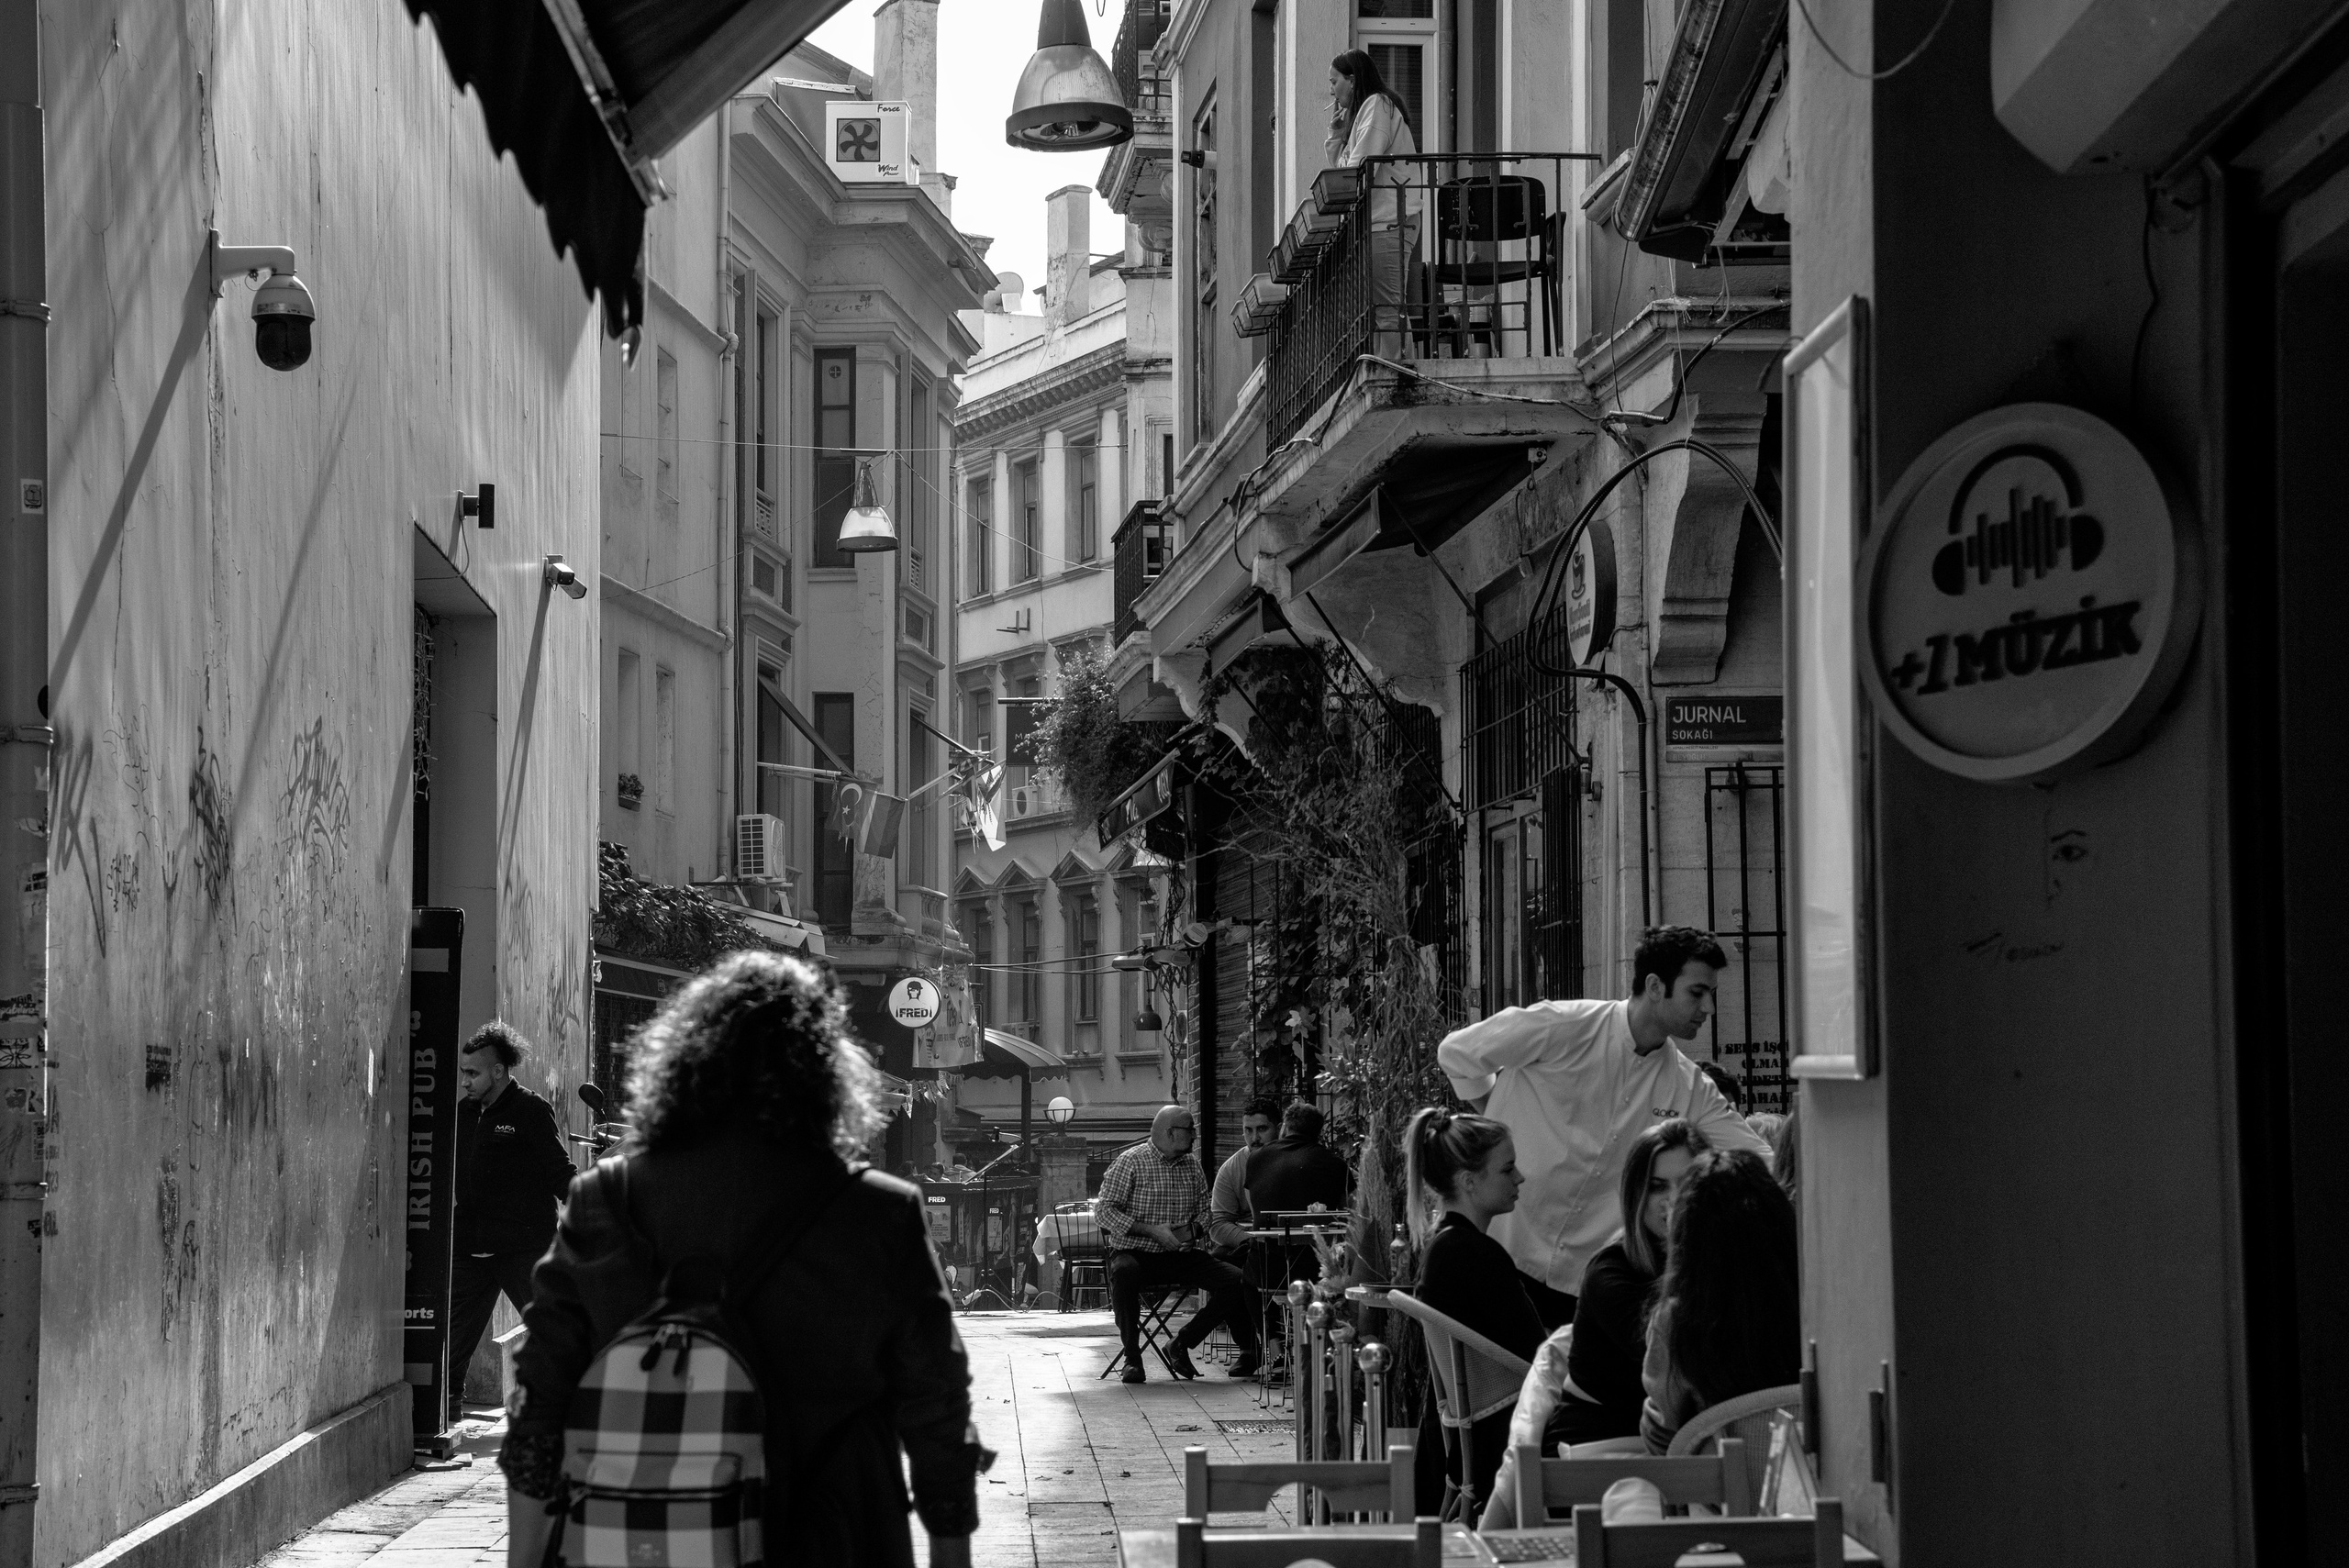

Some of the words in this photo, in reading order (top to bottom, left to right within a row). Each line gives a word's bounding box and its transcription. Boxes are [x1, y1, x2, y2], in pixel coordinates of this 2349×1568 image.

[877, 104, 900, 113] Force
[877, 164, 898, 172] Wind
[1673, 706, 1747, 723] JURNAL
[1672, 728, 1713, 740] SOKAĞI
[412, 1048, 437, 1117] PUB
[407, 1130, 434, 1231] IRISH
